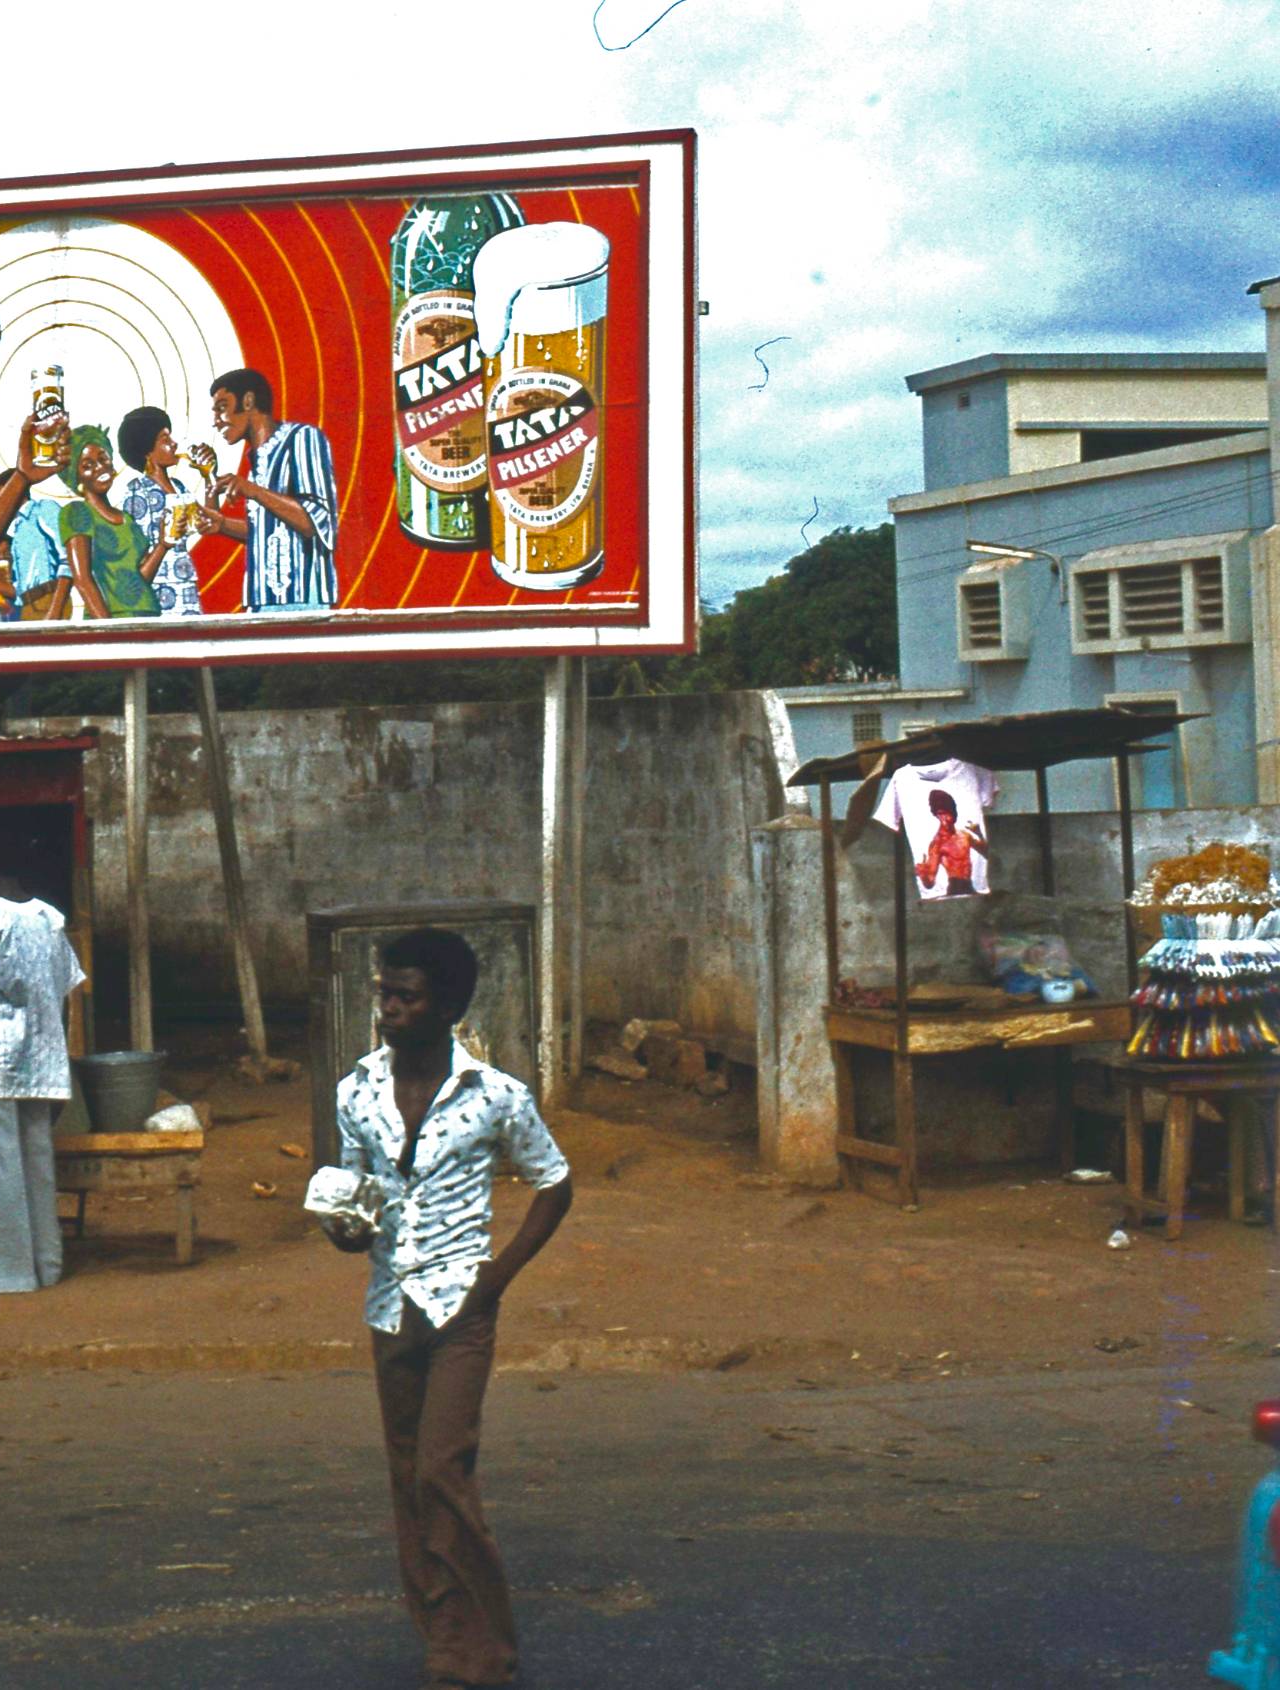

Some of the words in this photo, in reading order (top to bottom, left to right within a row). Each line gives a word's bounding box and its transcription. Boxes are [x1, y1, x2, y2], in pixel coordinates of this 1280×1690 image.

[404, 383, 484, 434] PILSENE
[494, 406, 586, 449] TATA
[419, 460, 438, 476] TATA
[496, 427, 589, 481] PILSENER
[510, 503, 526, 519] TATA
[530, 508, 568, 522] BREWERY
[582, 462, 594, 490] GHANA
